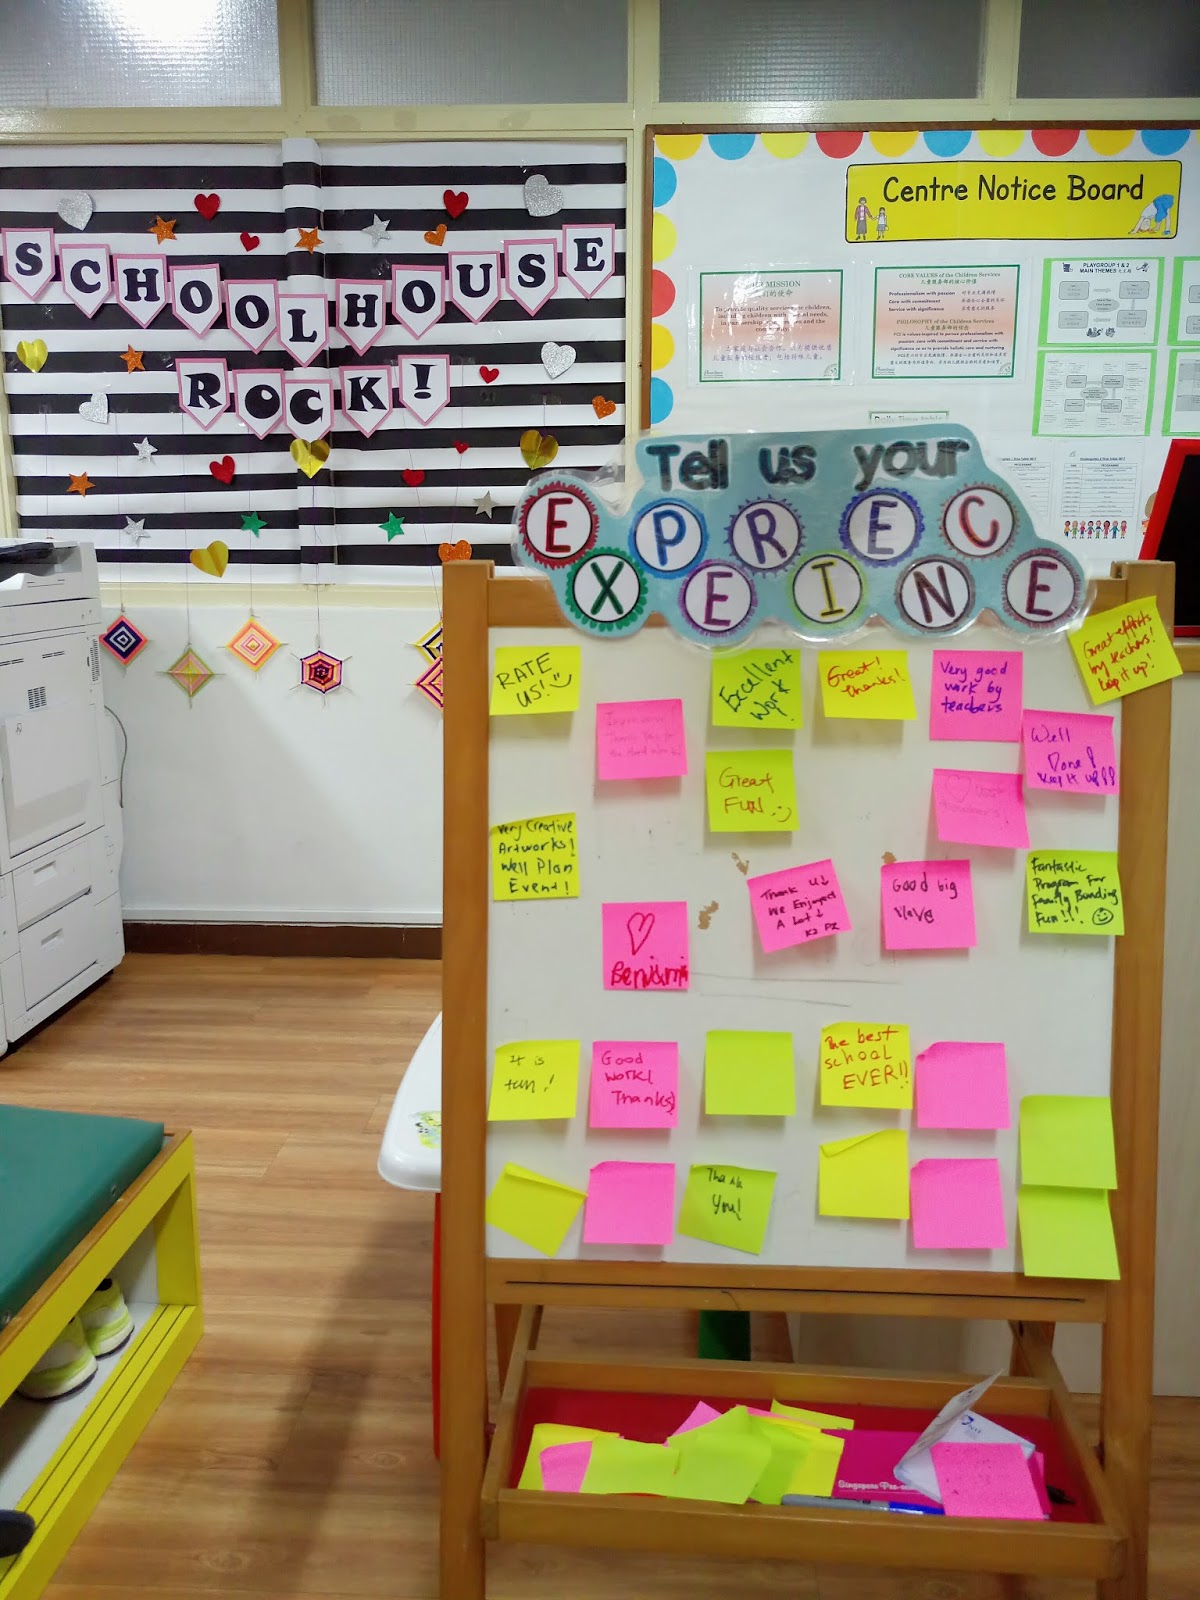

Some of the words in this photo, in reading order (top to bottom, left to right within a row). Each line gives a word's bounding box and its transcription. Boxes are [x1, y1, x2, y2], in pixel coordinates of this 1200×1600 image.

[883, 176, 968, 203] Centre
[979, 174, 1056, 201] Notice
[1067, 174, 1144, 201] Board
[187, 364, 432, 425] ROCK!
[645, 438, 729, 492] Tell
[758, 440, 815, 485] us
[853, 440, 970, 492] your
[1084, 632, 1113, 659] Great
[496, 652, 552, 690] RATE
[940, 661, 968, 683] Very
[976, 661, 1008, 683] good
[719, 650, 793, 712] Excellent
[944, 682, 978, 695] work
[987, 681, 1002, 704] by
[941, 696, 1002, 713] teachers
[1031, 724, 1070, 742] Well
[719, 766, 774, 793] Great
[526, 819, 573, 834] Creative
[537, 857, 573, 875] Plan
[1031, 857, 1087, 875] Fantastic
[760, 887, 798, 900] Thank
[893, 871, 928, 892] Good
[937, 878, 958, 899] big
[793, 891, 836, 910] Enjoyed
[1075, 886, 1118, 905] Bonding
[777, 919, 785, 930] A
[857, 1025, 899, 1044] best
[534, 1055, 545, 1066] is
[601, 1050, 643, 1066] Good
[706, 1167, 743, 1189] Thank
